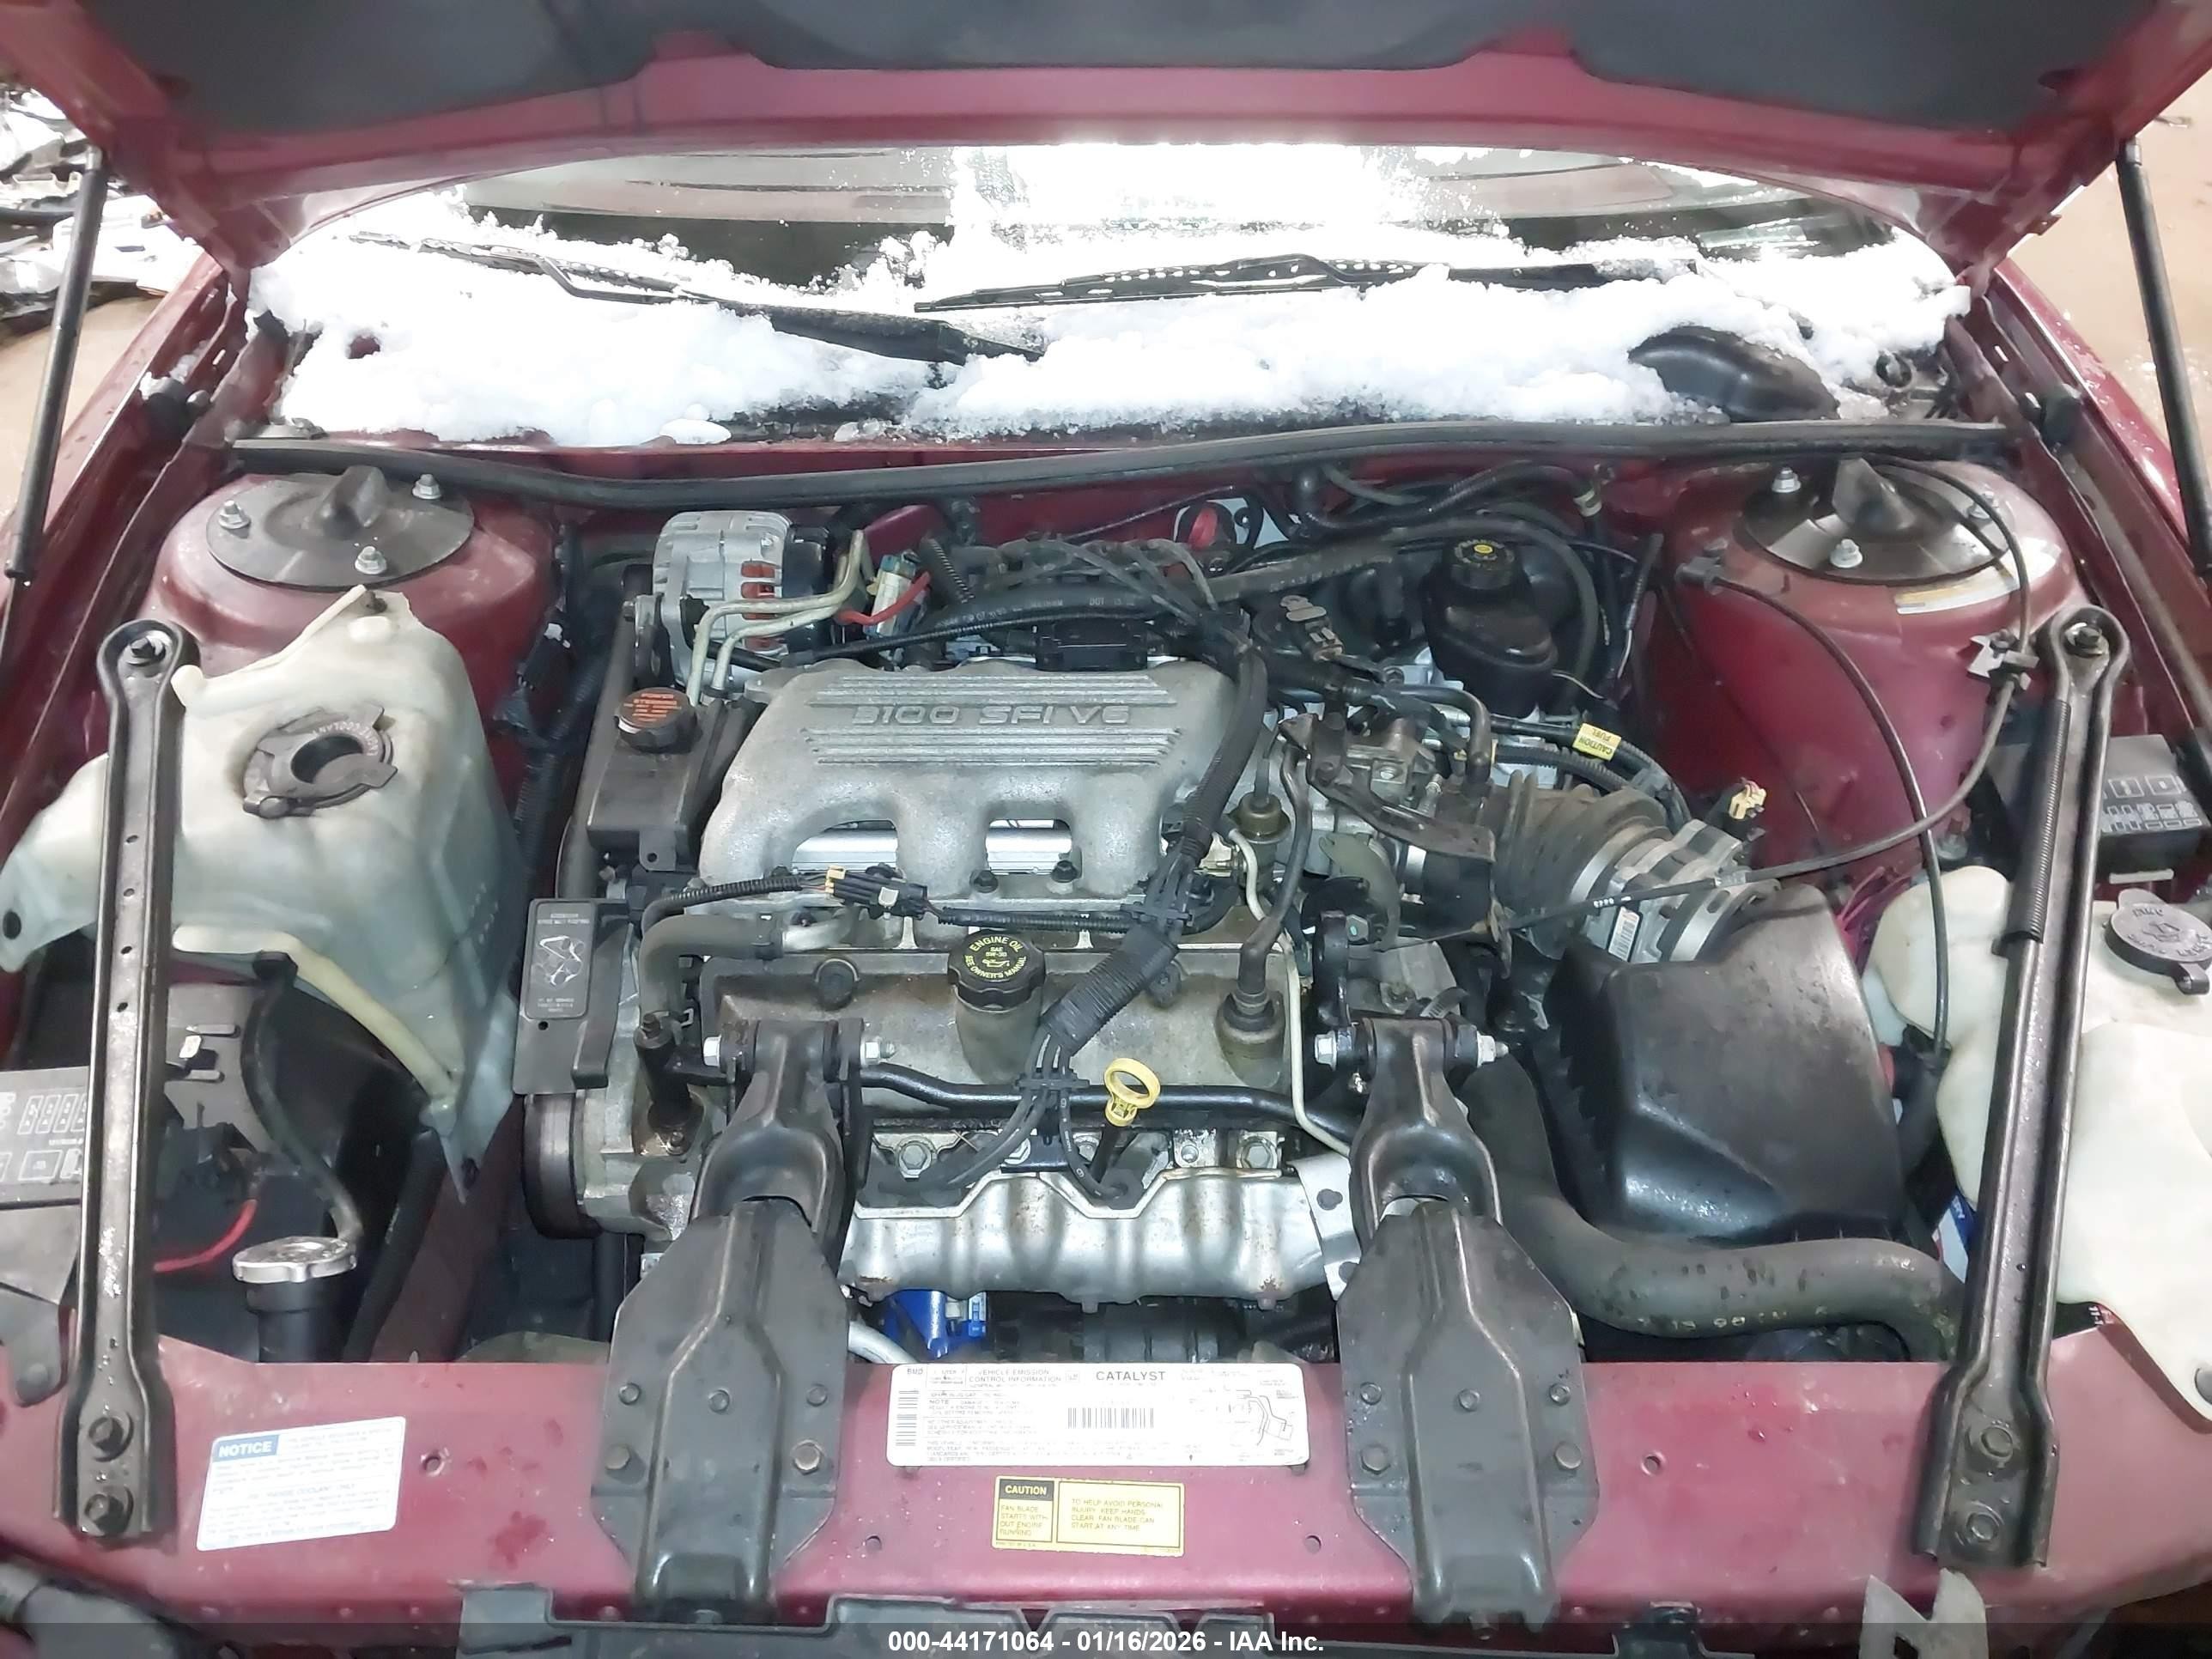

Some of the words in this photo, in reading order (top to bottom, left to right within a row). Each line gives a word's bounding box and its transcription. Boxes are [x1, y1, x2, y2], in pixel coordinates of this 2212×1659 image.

[853, 705, 960, 725] 3100
[980, 705, 1055, 725] SFI
[1070, 705, 1129, 725] V6
[1579, 736, 1613, 755] CAUTION
[969, 936, 1009, 951] ENGINE
[1009, 940, 1024, 952] OIL
[964, 955, 975, 967] SEE
[970, 966, 1004, 978] OWNER'S
[1004, 956, 1027, 976] MANUAL
[1096, 1370, 1166, 1381] CATALYST
[219, 1441, 272, 1458] NOTICE
[1006, 1485, 1047, 1496] CAUTION
